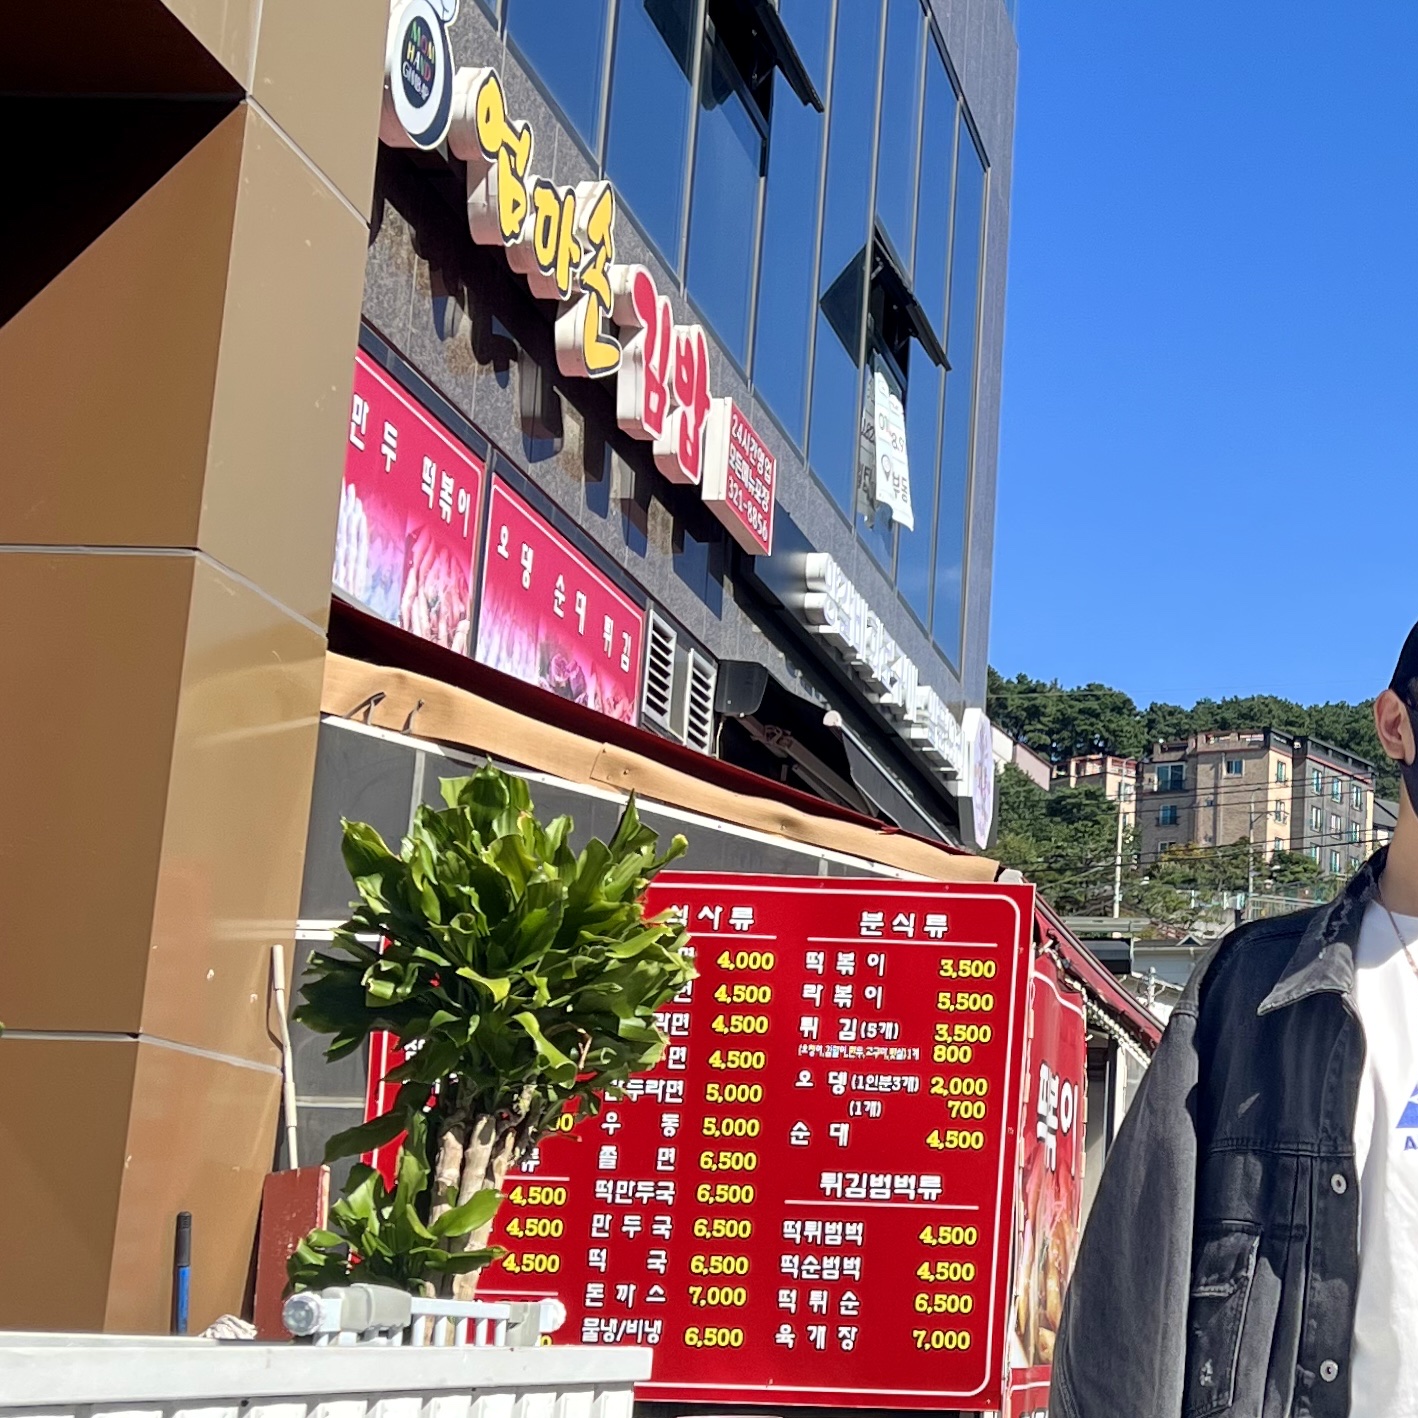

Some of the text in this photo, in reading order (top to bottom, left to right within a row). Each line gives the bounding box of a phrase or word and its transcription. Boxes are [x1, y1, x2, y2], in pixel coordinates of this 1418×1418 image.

[406, 41, 432, 82] HAND
[475, 76, 712, 481] 엄마손 김밥
[731, 413, 773, 486] 24시간영업
[350, 393, 472, 538] 만두 떡볶이
[727, 475, 769, 542] 321-8856
[496, 524, 534, 590] 오뎅
[553, 573, 587, 635] 순대
[859, 910, 949, 939] 분식류
[716, 950, 776, 971] 4,000
[805, 951, 997, 980] 떡볶이 3,500
[713, 983, 773, 1005] 4,500
[936, 991, 995, 1012] 5,500
[710, 1014, 770, 1035] 4,500
[933, 1023, 993, 1044] 3,500
[707, 1049, 767, 1070] 4,500
[932, 1044, 973, 1064] 800
[704, 1083, 764, 1104] 5,000
[929, 1076, 989, 1097] 2,000
[848, 1099, 987, 1120] (1개) 700
[701, 1116, 761, 1138] 5,000
[925, 1129, 985, 1150] 4,500
[699, 1150, 758, 1171] 6,500
[508, 1184, 568, 1207] 4,500
[594, 1178, 755, 1206] 떡만두국 6,500
[819, 1171, 943, 1202] 튀김범벅류
[505, 1217, 564, 1239] 4,500
[590, 1212, 752, 1240] 만두국 6,500
[782, 1220, 979, 1247] 떡튀범벅 4,500
[501, 1252, 561, 1274] 4,500
[689, 1254, 749, 1276] 6,500
[780, 1254, 976, 1282] 떡순범벅 4,500
[583, 1281, 747, 1310] 돈까스 7,000
[777, 1288, 974, 1317] 떡튀순 6,500
[581, 1316, 663, 1345] 물냉/비냉
[683, 1326, 745, 1349] 6,500
[775, 1323, 972, 1351] 육개장 7,000
